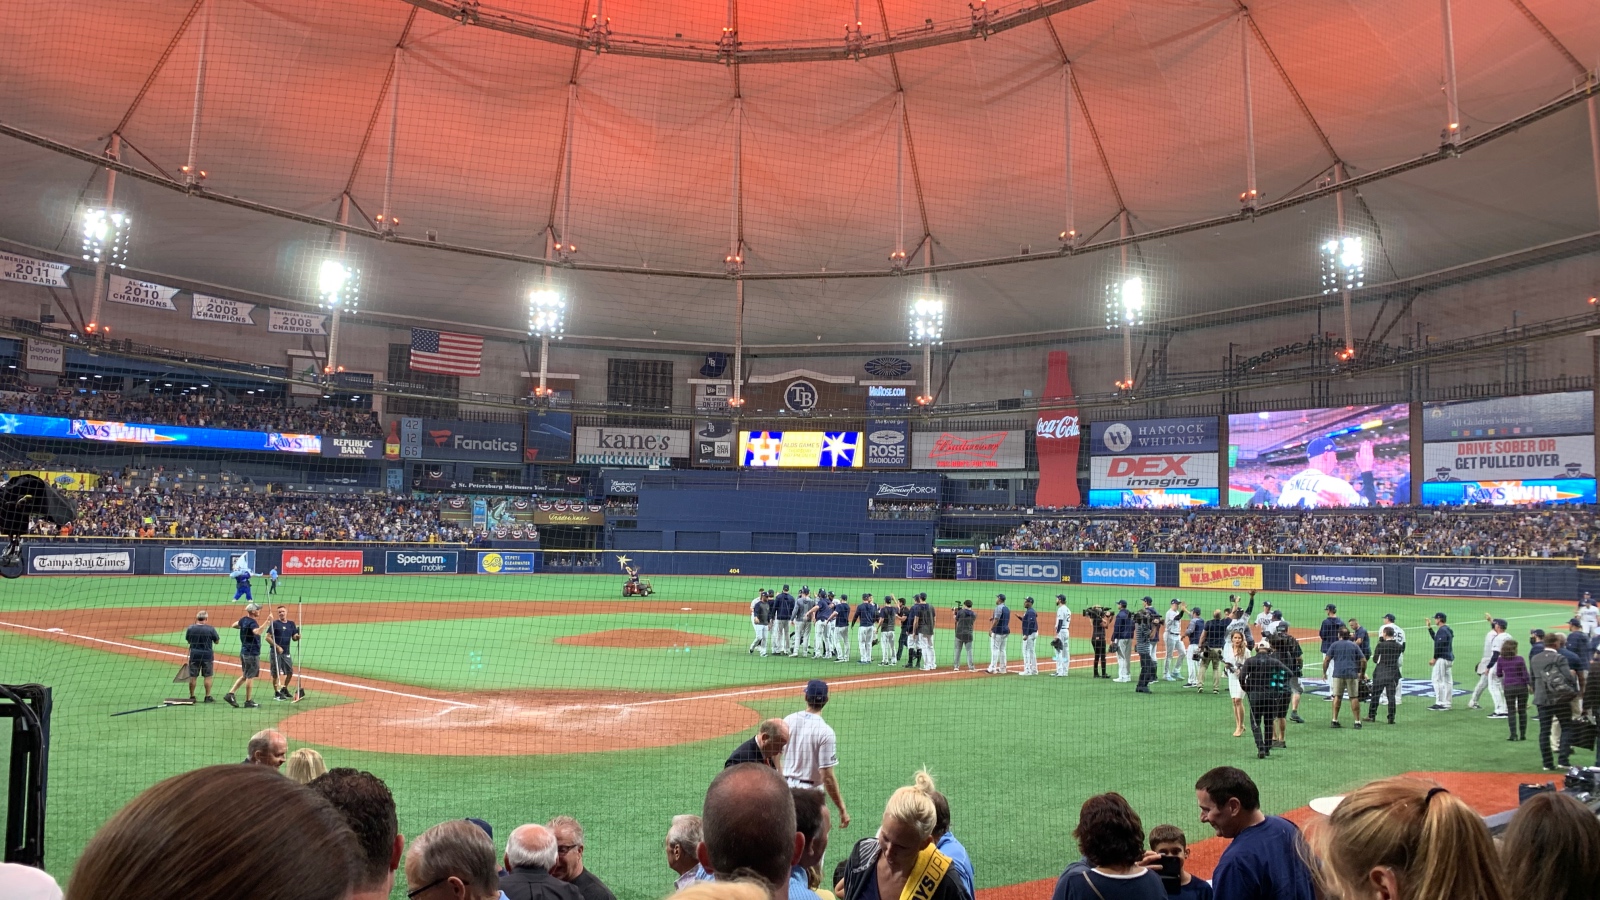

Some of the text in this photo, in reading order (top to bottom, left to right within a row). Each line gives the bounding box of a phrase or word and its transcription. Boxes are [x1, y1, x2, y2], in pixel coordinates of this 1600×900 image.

[0, 254, 64, 270] AMERICAN LEAGUE
[15, 264, 49, 277] 2011
[5, 271, 57, 285] WILD CARD
[125, 286, 159, 300] 2010
[113, 293, 167, 308] CHAMPIONS
[206, 304, 239, 316] 2008
[197, 311, 246, 323] CHAMPIONS
[282, 316, 312, 327] 2008
[273, 324, 319, 334] CHAMPIONS
[30, 345, 61, 354] beyond
[30, 354, 59, 363] money
[791, 386, 813, 407] TB
[68, 420, 155, 441] RAYS WIN
[405, 420, 418, 430] 42
[1036, 416, 1080, 438] Coca-Cola
[1139, 424, 1204, 435] HANCOCK
[265, 433, 303, 450] RAYS
[333, 438, 374, 448] REPUBLIC
[407, 433, 417, 443] 12
[454, 434, 518, 452] Fanatics
[597, 429, 671, 450] kane's
[1139, 436, 1204, 446] WHITNEY
[341, 446, 365, 454] BANK
[869, 445, 905, 457] ROSE
[936, 439, 999, 451] Budweiser
[1457, 439, 1556, 455] DRIVE SOBER OR
[405, 447, 418, 456] 66
[1107, 456, 1192, 477] DEX
[1455, 454, 1560, 469] GET PULLED OVER
[1127, 477, 1199, 487] imaging
[1290, 479, 1319, 493] SNELL
[1462, 484, 1557, 500] RAYS WIN
[38, 556, 125, 569] Tampa Bay Times
[177, 556, 226, 567] FOX SUN
[304, 556, 360, 568] State Farm
[397, 554, 444, 566] Spectrum
[998, 564, 1058, 578] GEICO
[1087, 567, 1135, 578] SAGICOR
[912, 856, 944, 900] YSUP
